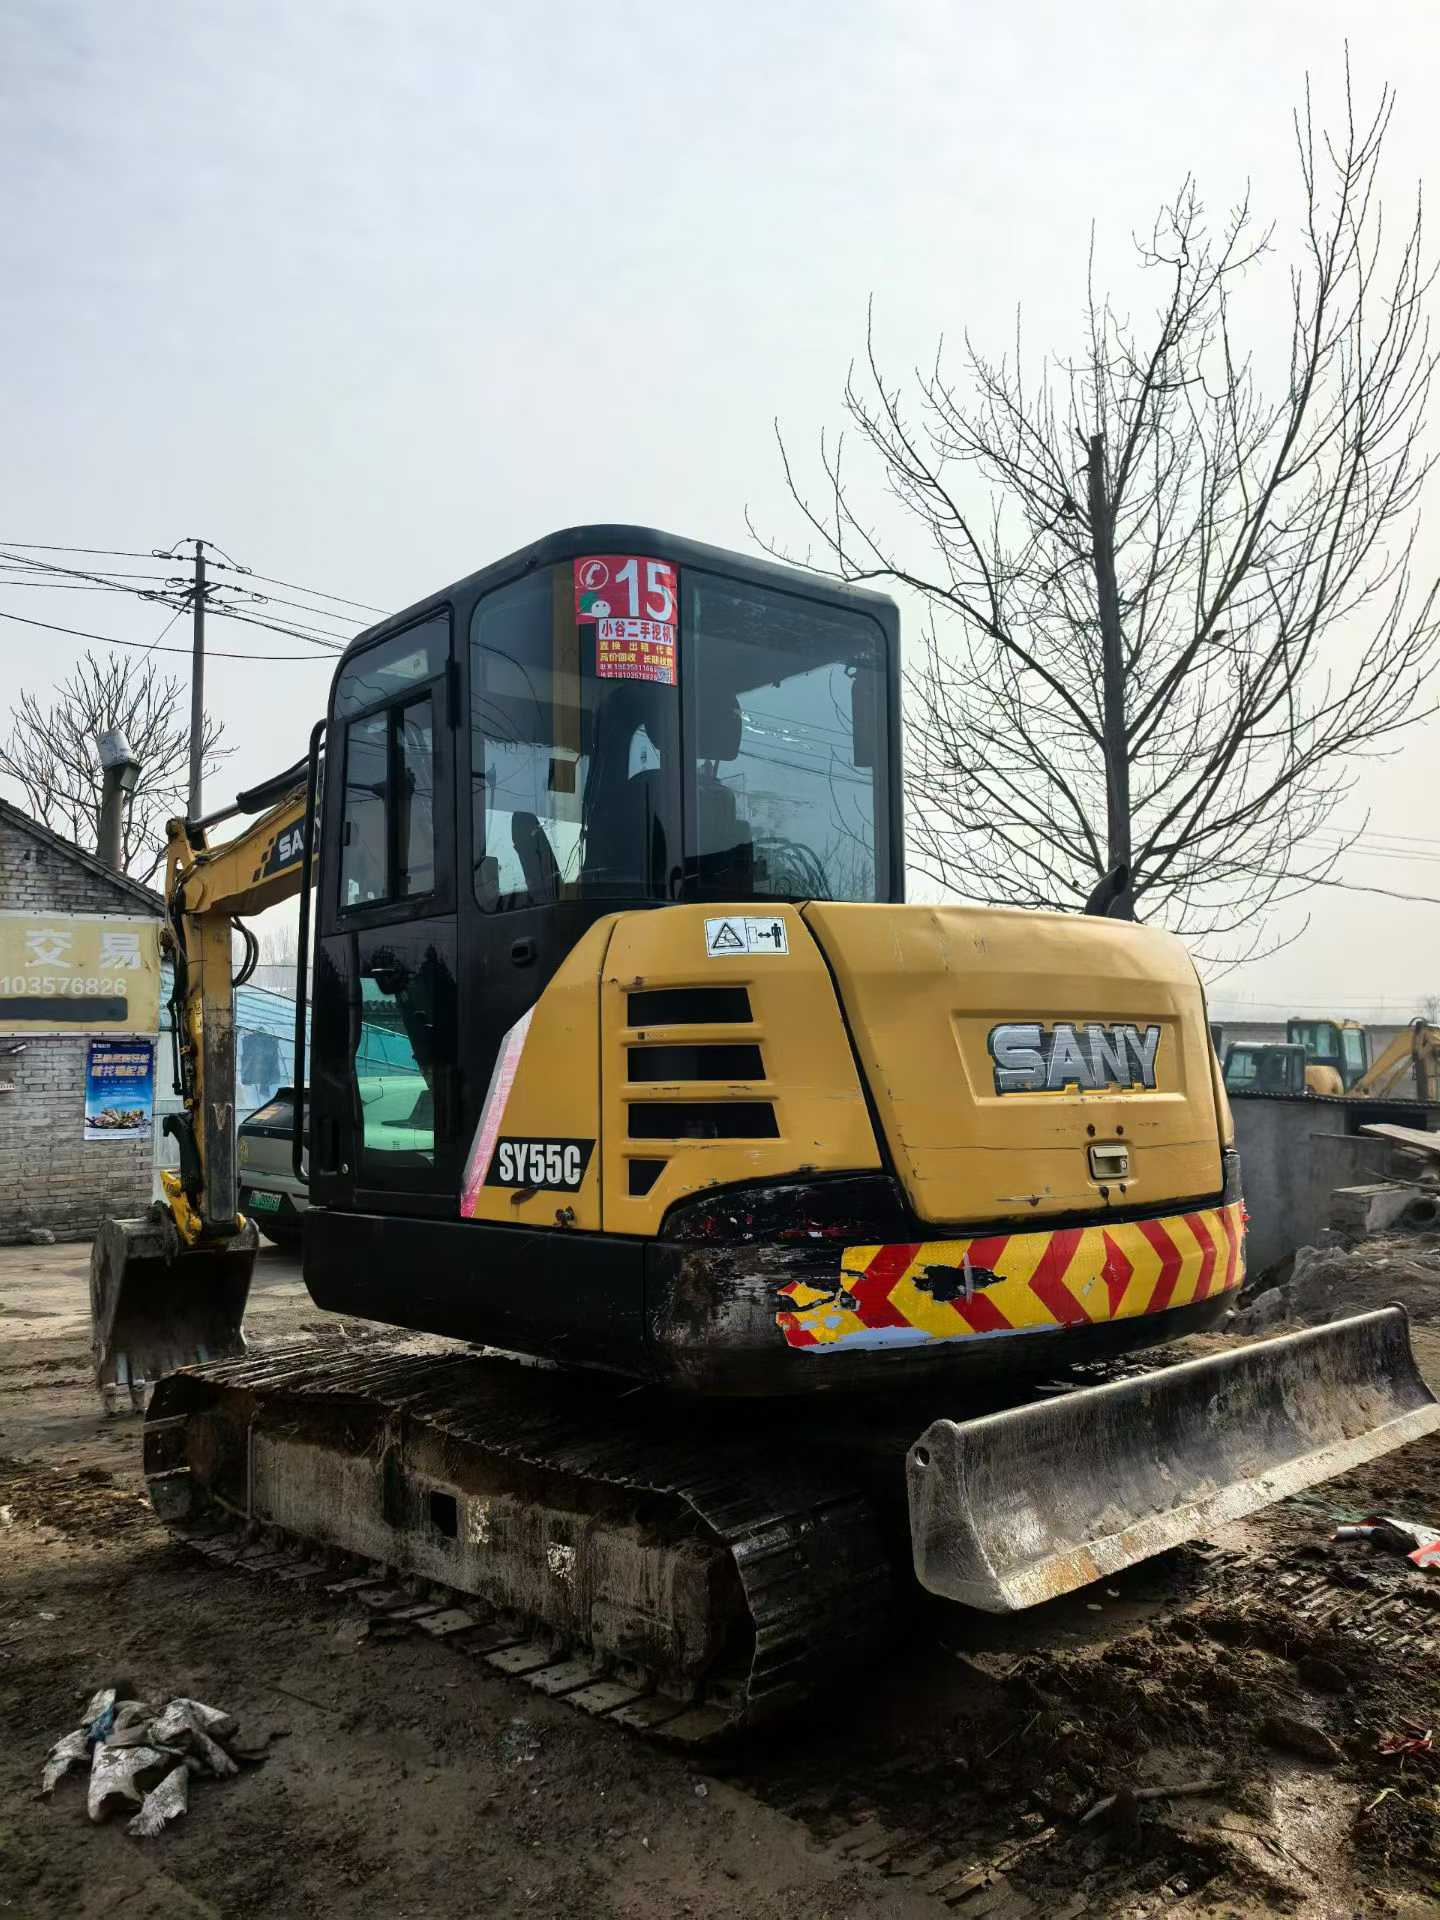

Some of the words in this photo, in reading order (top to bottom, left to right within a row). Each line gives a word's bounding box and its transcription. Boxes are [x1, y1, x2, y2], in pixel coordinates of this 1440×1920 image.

[615, 559, 673, 621] 15
[25, 929, 141, 970] 交易
[0, 975, 128, 996] 103576826
[989, 1023, 1161, 1093] SANY
[498, 1141, 581, 1185] SY55C
